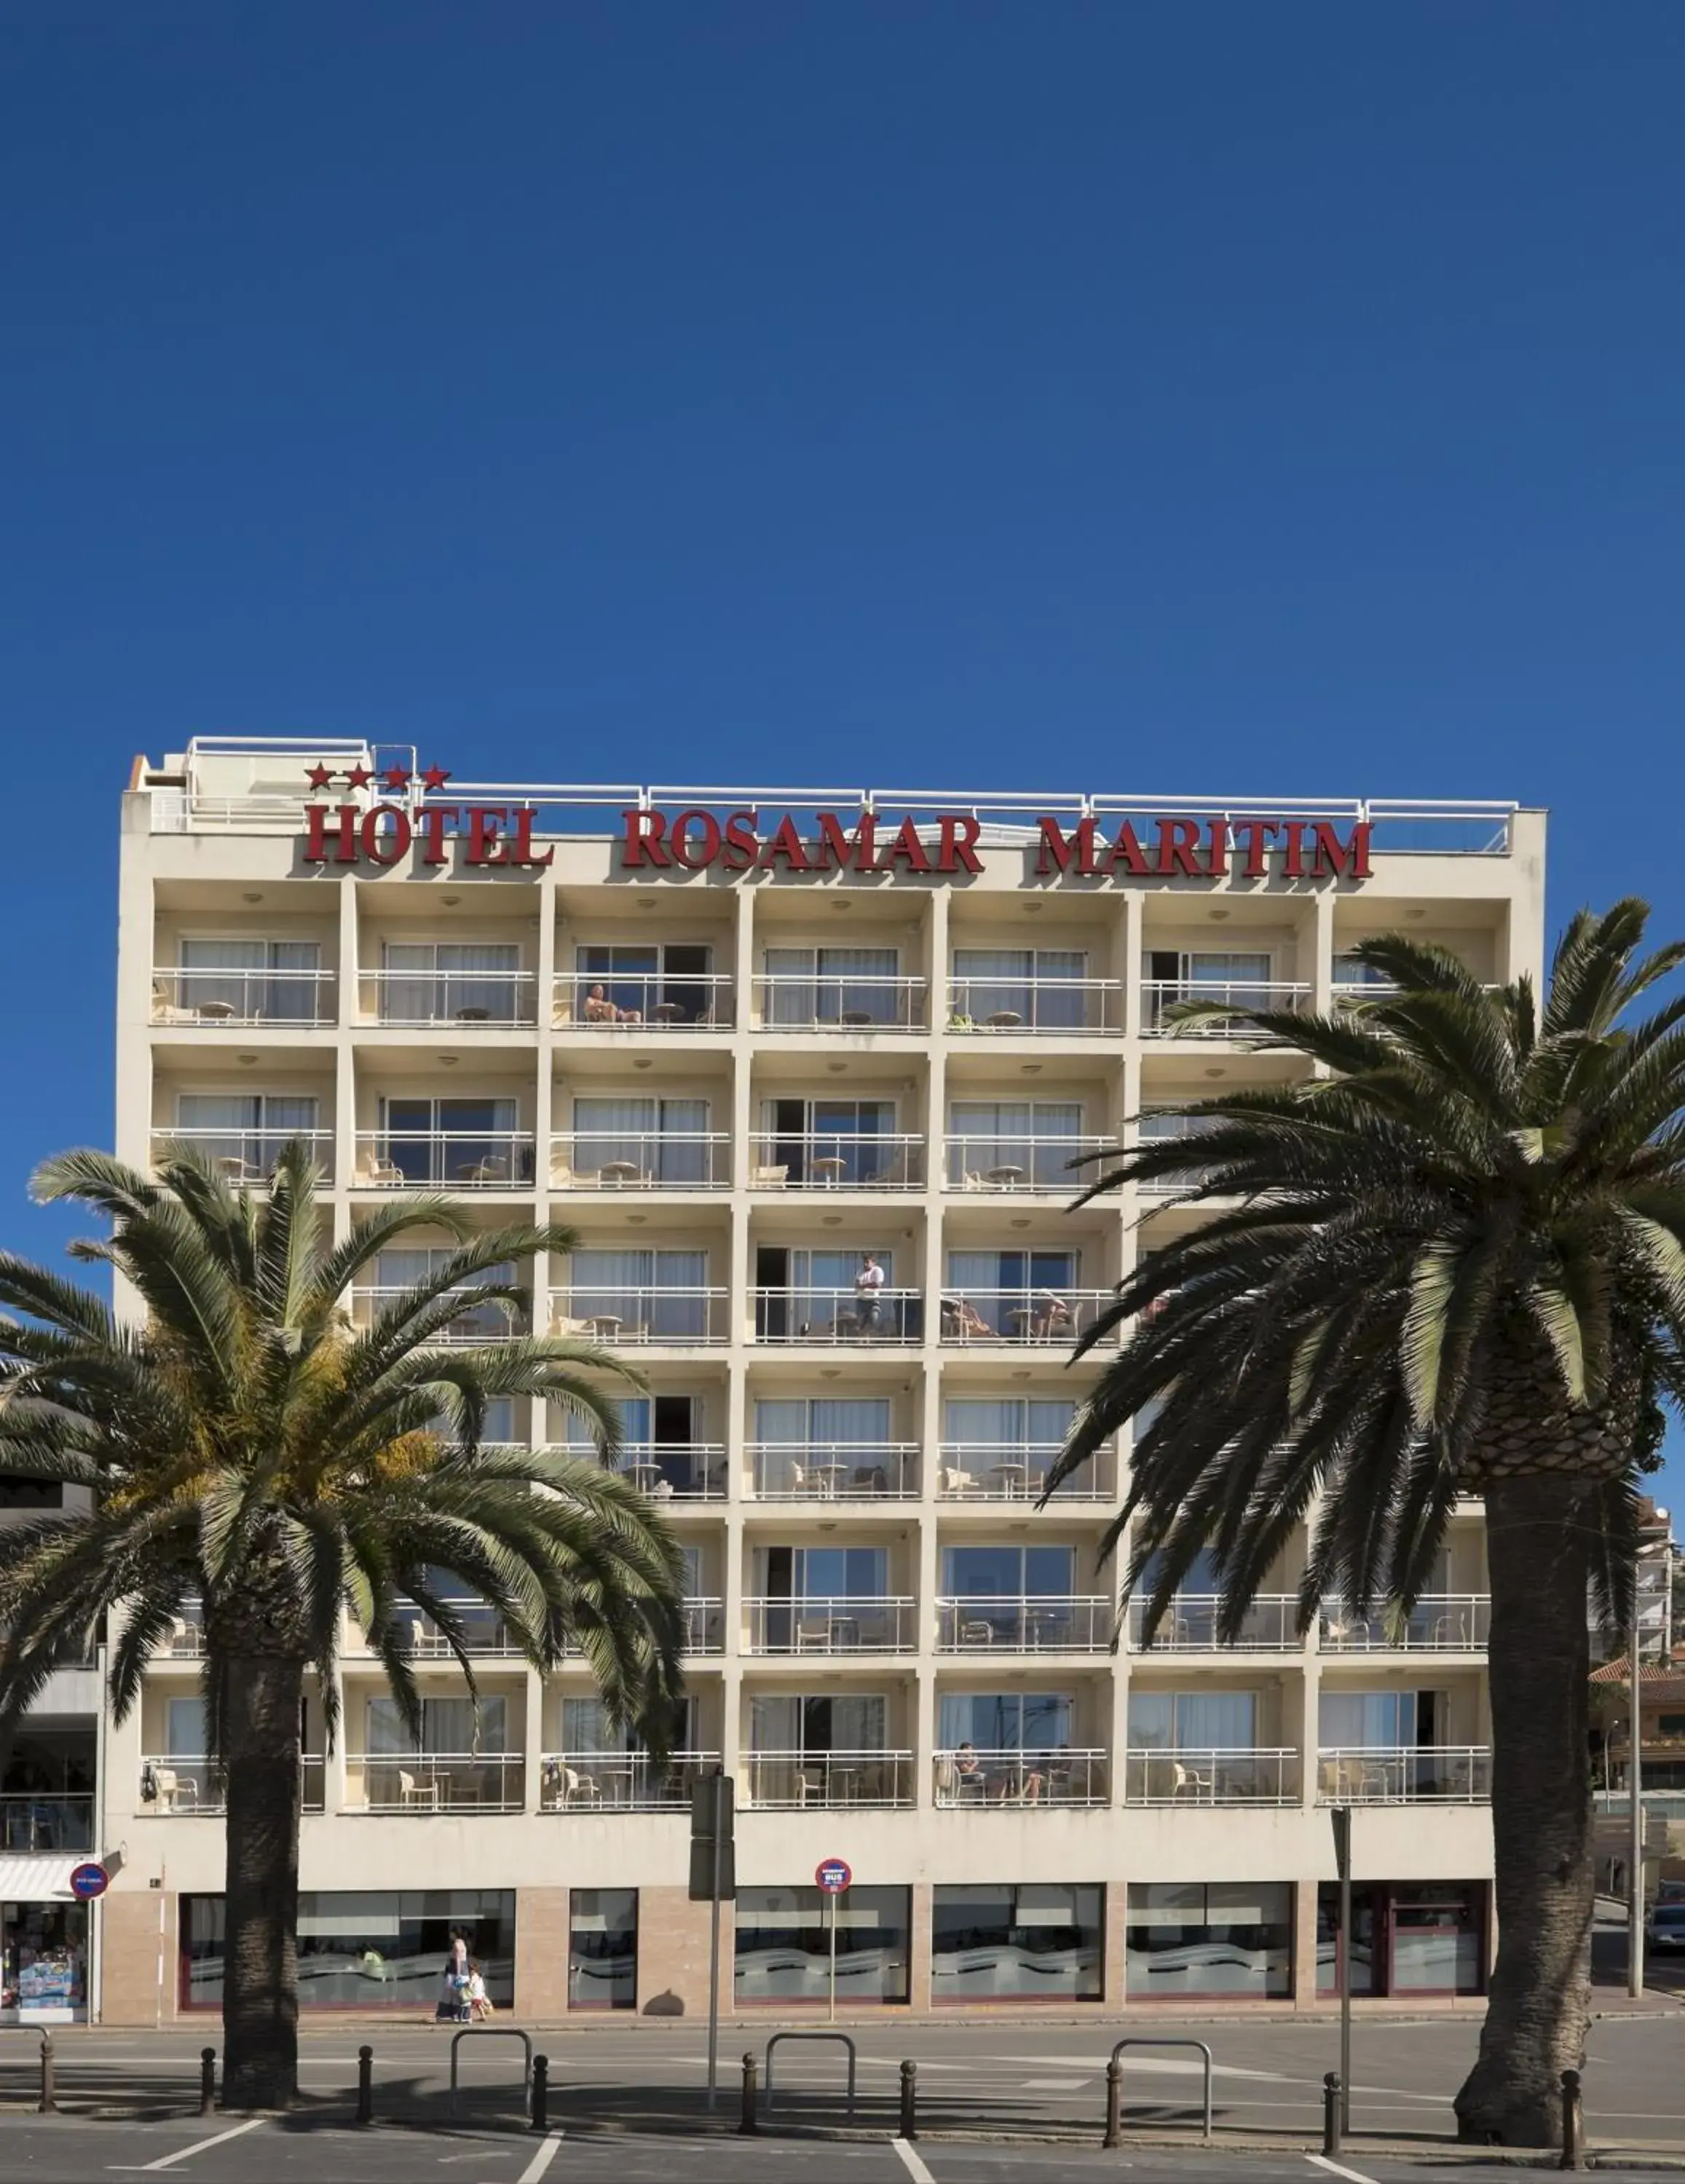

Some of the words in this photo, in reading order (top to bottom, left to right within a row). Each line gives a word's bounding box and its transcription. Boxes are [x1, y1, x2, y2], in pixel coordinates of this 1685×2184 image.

[303, 804, 556, 866] HOTEL
[621, 808, 987, 874] ROSAMAR
[1035, 816, 1376, 879] MARITIM
